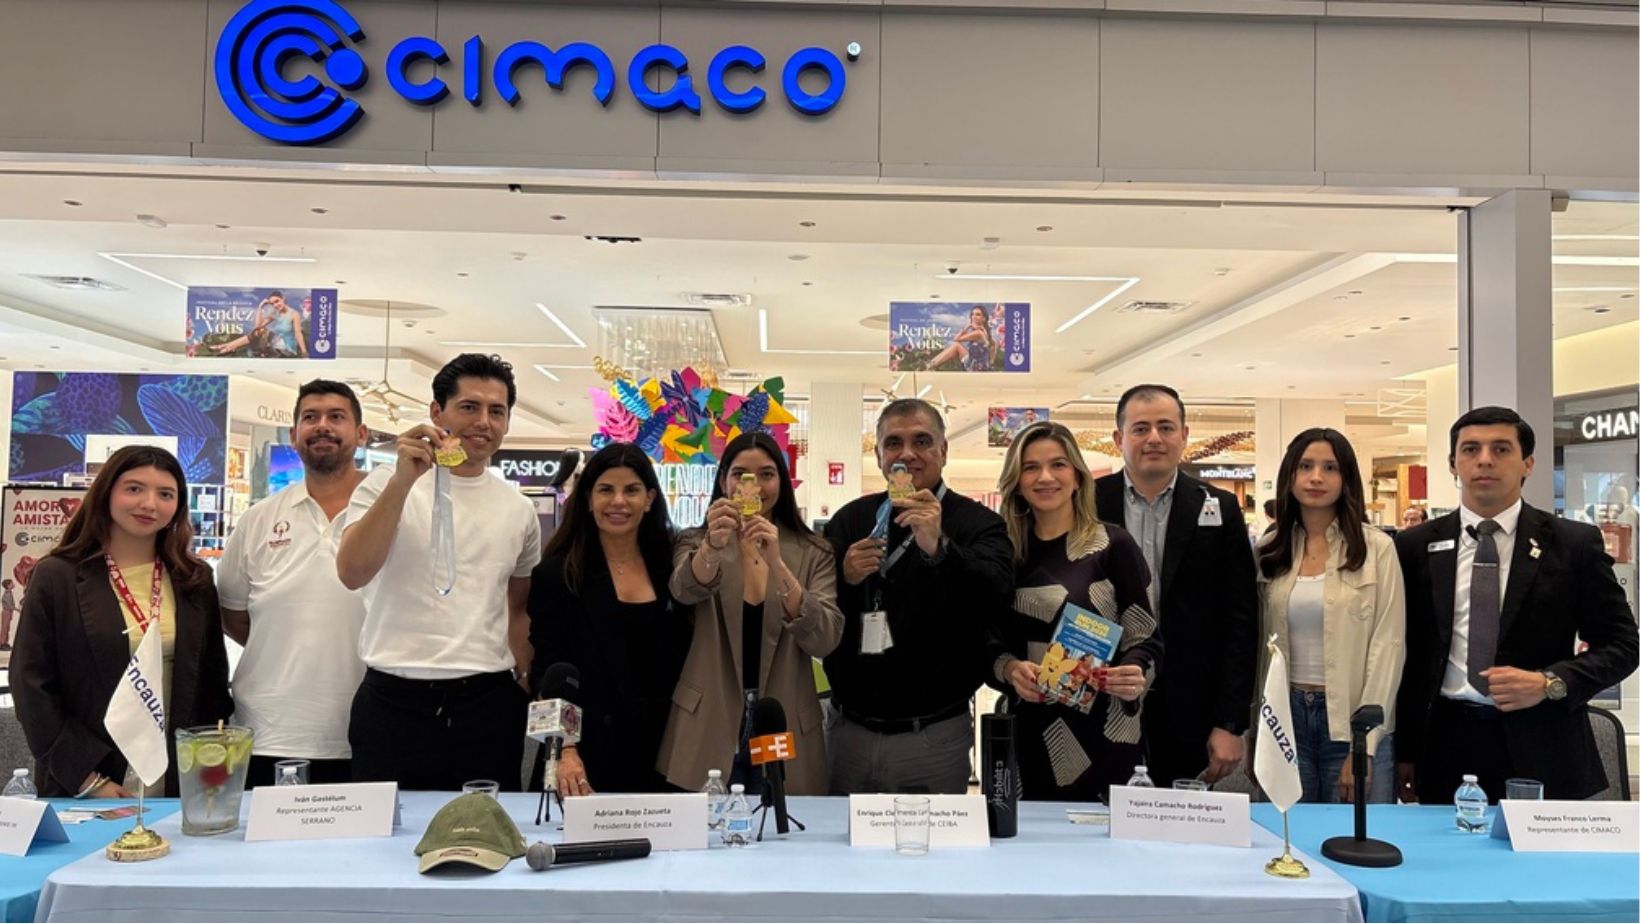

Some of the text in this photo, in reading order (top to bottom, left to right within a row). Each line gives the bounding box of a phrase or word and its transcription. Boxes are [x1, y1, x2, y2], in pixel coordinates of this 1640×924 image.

[195, 306, 255, 321] Rendez
[203, 319, 244, 334] Vous
[899, 323, 952, 337] Rendez
[906, 336, 945, 350] Vous
[501, 460, 560, 477] FASHIO
[13, 500, 60, 512] AMOR
[276, 804, 363, 815] Representante AGENCIA
[1154, 800, 1187, 810] Camacho
[594, 809, 623, 817] Adriana
[857, 810, 884, 818] Enrique
[1126, 811, 1158, 820] Directora
[1159, 814, 1184, 822] general
[300, 817, 336, 825] SERRANO
[593, 822, 632, 831] Presidenta
[633, 821, 643, 830] de
[937, 820, 958, 828] CEIBA
[1527, 826, 1579, 834] Representante
[1591, 826, 1622, 834] CIMACO
